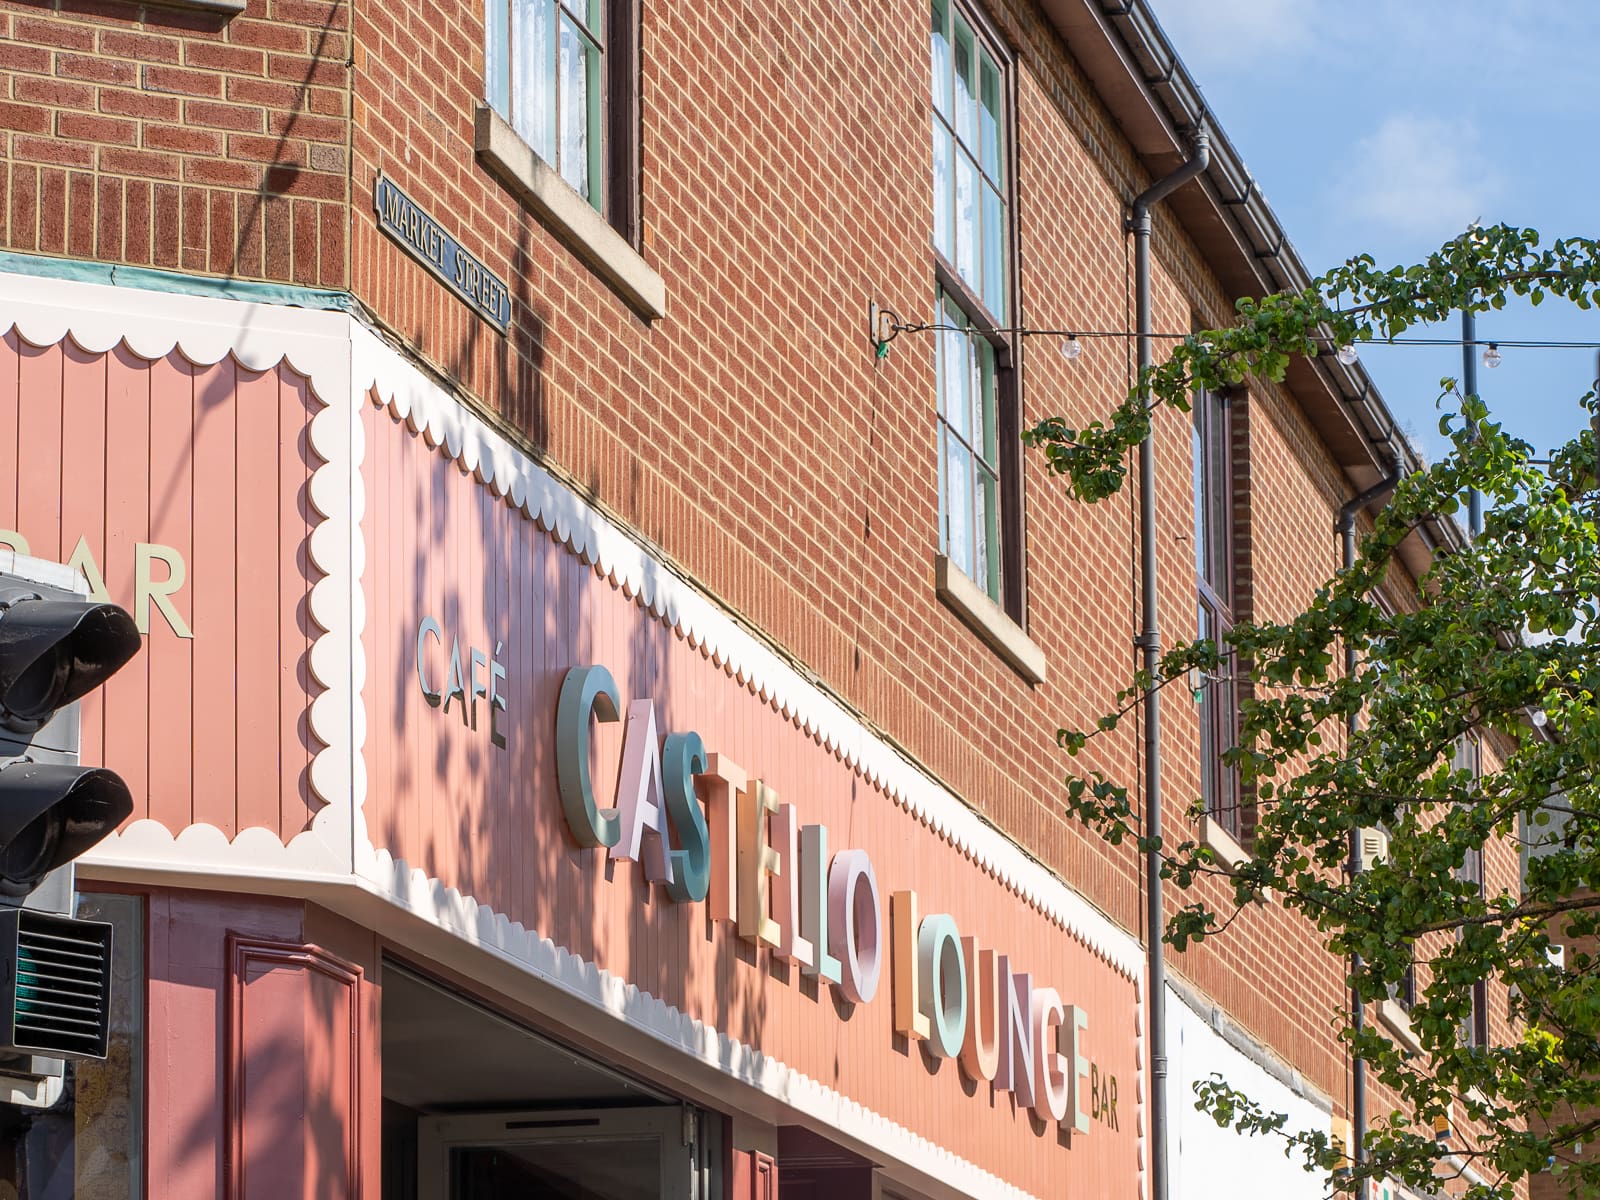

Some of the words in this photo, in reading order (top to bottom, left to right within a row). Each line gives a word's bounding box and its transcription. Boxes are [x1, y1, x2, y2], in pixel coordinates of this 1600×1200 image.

[384, 184, 447, 268] MARKET
[455, 249, 506, 321] STREET
[0, 529, 194, 639] AR
[417, 615, 506, 712] CAFÉ
[556, 664, 882, 1004] CASTELLO
[893, 890, 1090, 1136] LOUNGE
[1091, 1062, 1119, 1133] BAR
